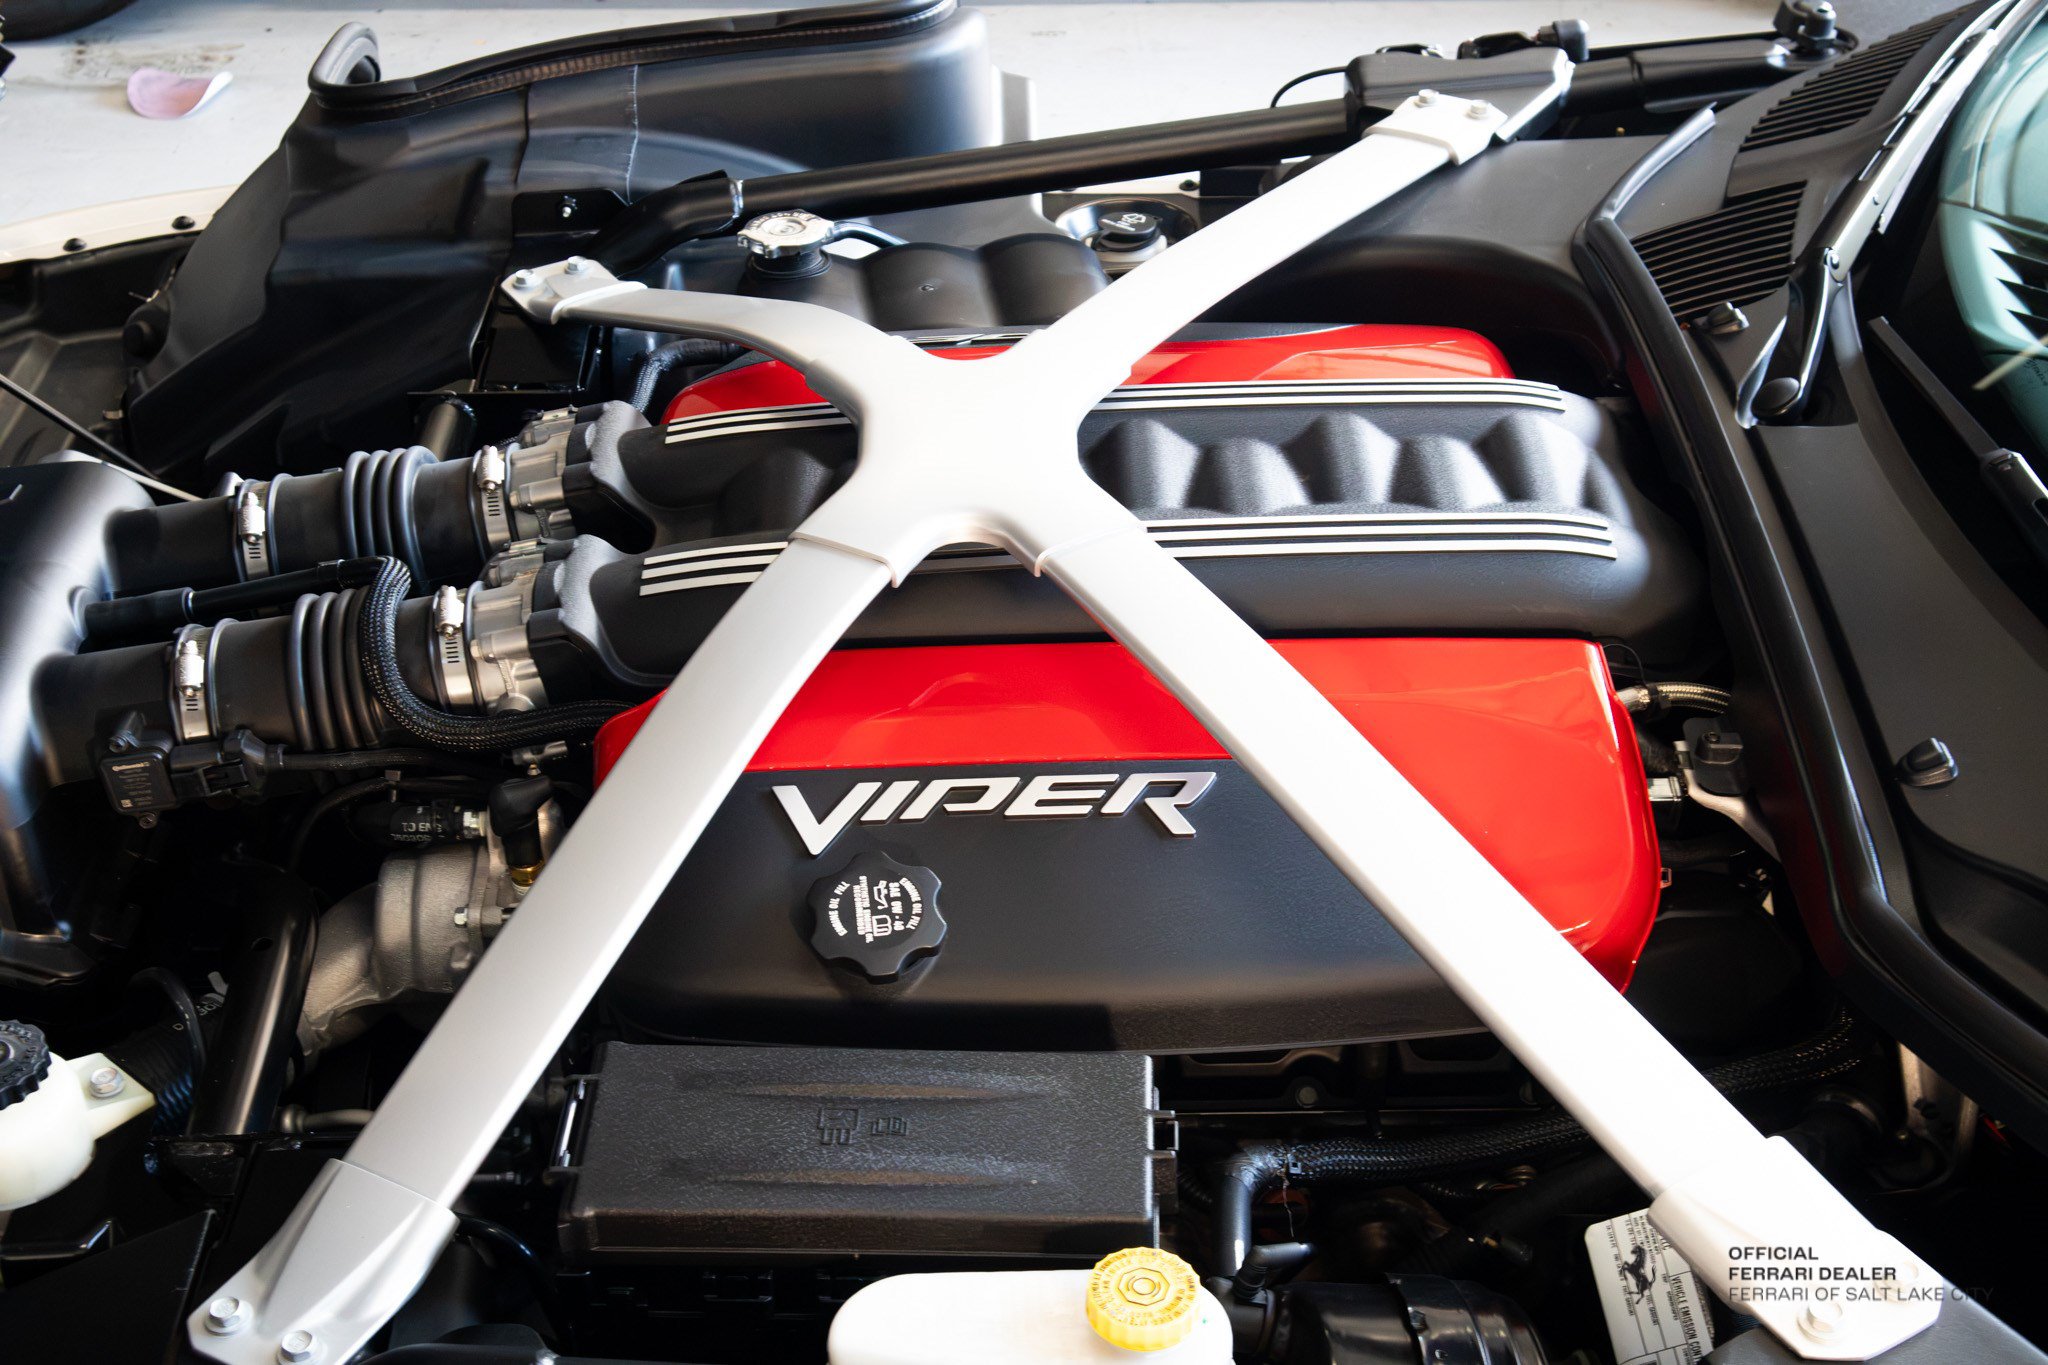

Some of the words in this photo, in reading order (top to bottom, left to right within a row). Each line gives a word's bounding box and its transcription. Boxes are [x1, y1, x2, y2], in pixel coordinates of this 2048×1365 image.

[771, 772, 1217, 856] VIPER
[833, 881, 851, 896] FILL
[889, 882, 901, 897] SAE
[899, 877, 921, 902] ENGINE
[828, 897, 841, 909] OIL
[912, 903, 922, 914] OIL
[828, 910, 849, 937] ENGINE
[905, 915, 921, 930] FILL
[1672, 1275, 1689, 1305] VEHICLE
[1679, 1305, 1699, 1341] EMISSION
[1688, 1340, 1704, 1362] CONT
